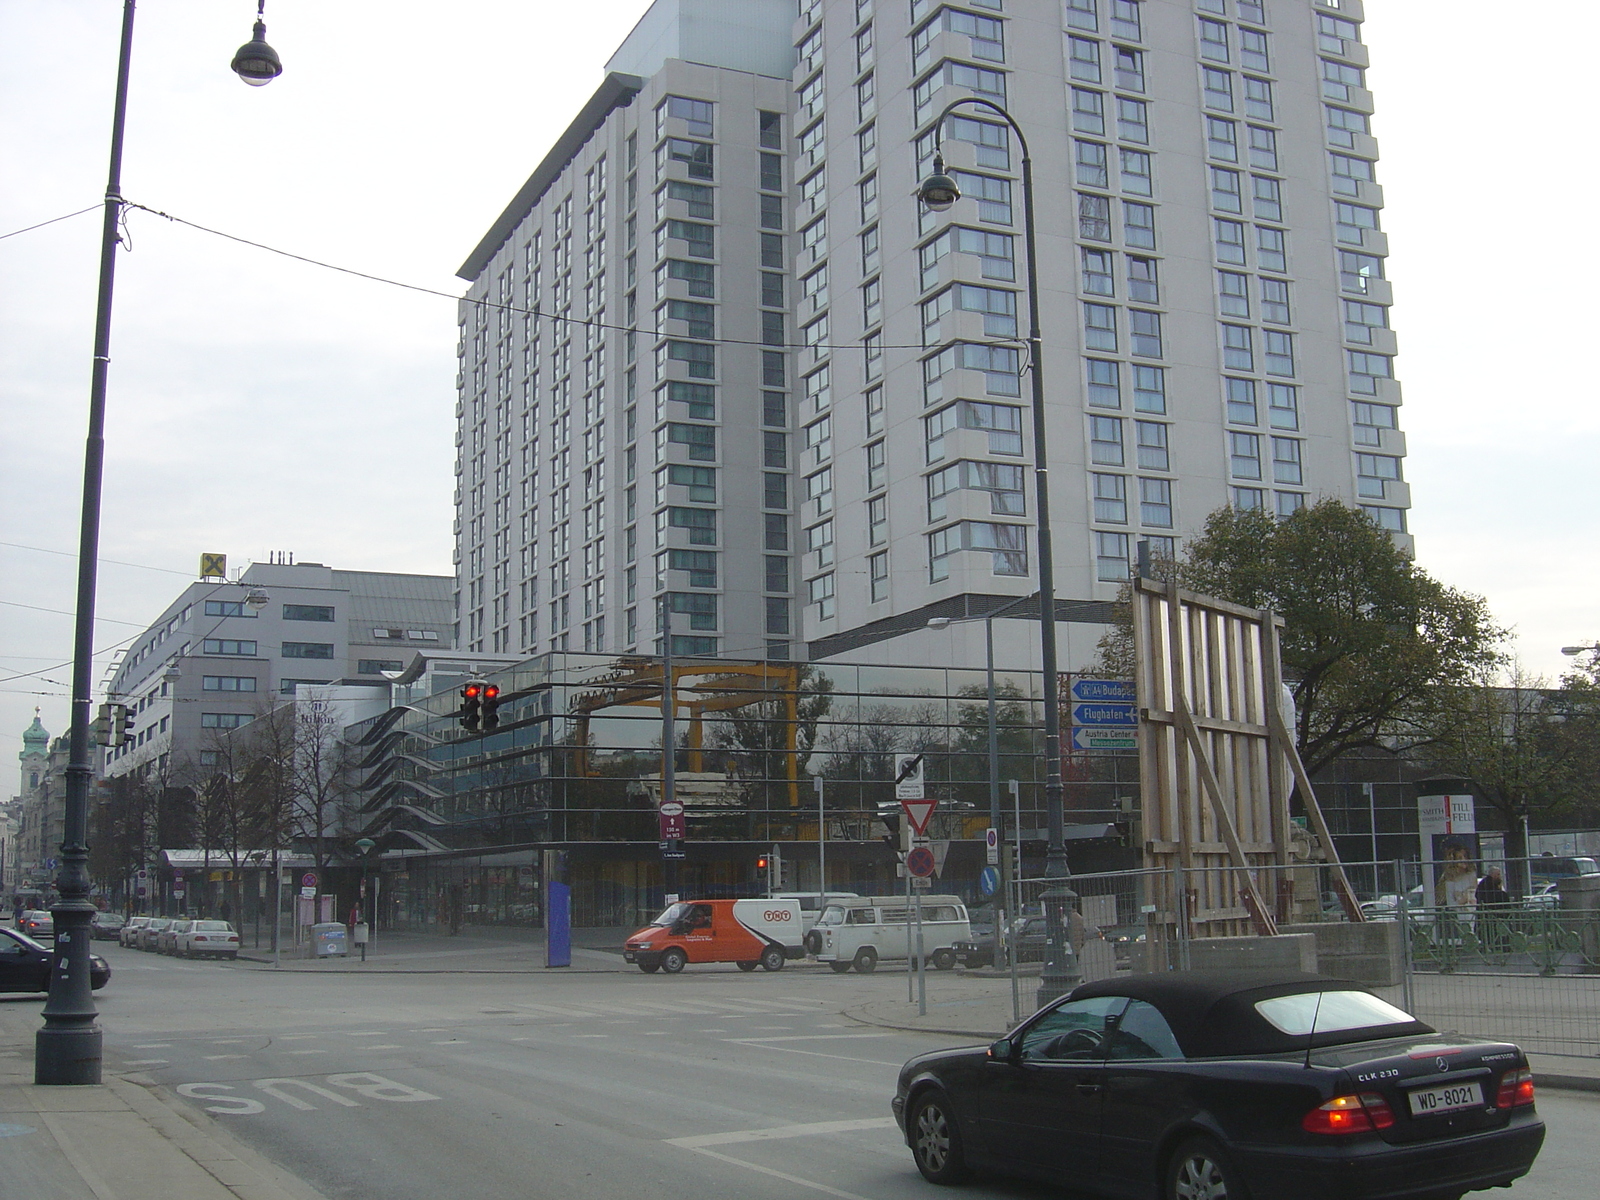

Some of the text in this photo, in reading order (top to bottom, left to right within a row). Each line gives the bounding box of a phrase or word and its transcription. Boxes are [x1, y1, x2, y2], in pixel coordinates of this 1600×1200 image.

[1103, 684, 1136, 698] Budapes
[301, 713, 335, 724] Hilton
[1084, 707, 1124, 721] Flughafen
[1085, 729, 1131, 738] Austria Center
[1452, 803, 1470, 812] TILL
[765, 911, 791, 922] TNT
[1480, 1052, 1515, 1062] KOMPRESSOR
[1358, 1069, 1399, 1082] CLK 230
[176, 1072, 442, 1115] BUS
[1417, 1086, 1474, 1110] WD-8021
